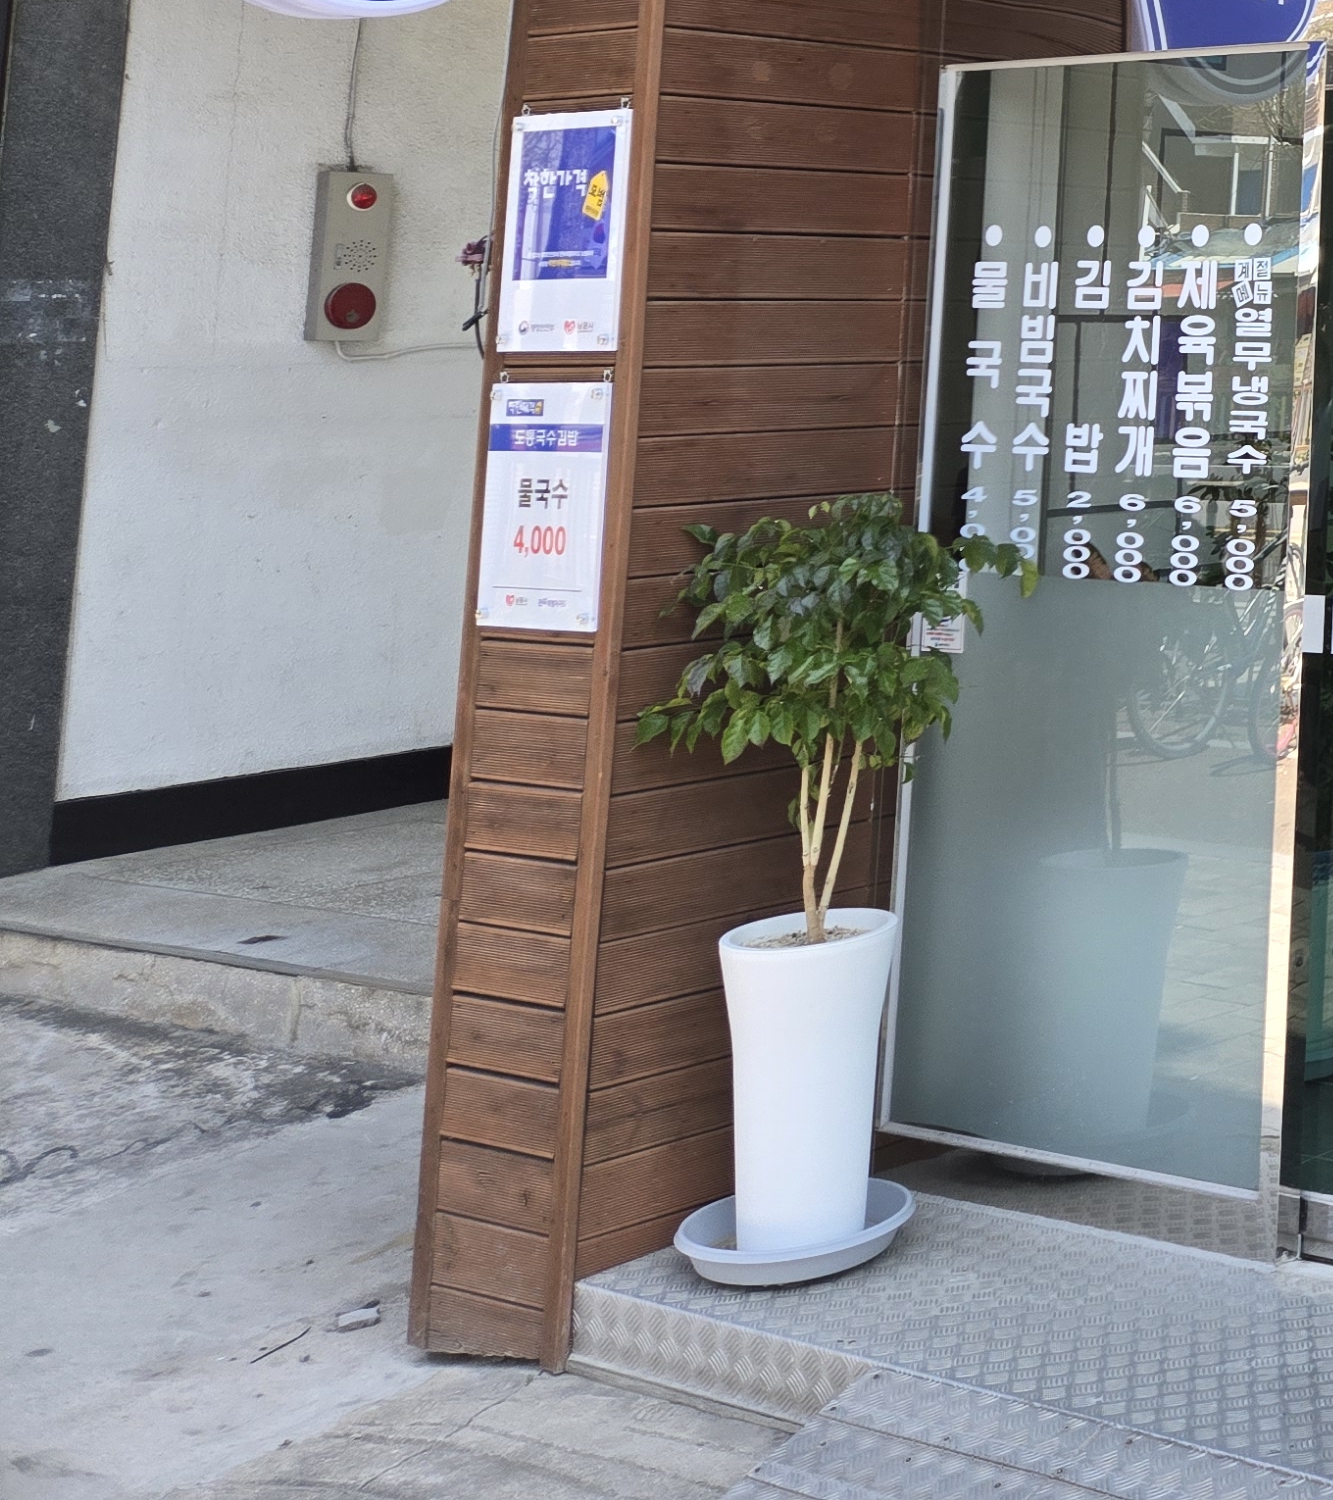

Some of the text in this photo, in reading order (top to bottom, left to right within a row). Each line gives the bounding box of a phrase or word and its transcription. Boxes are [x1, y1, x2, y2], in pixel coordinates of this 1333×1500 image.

[514, 429, 579, 447] 도통국수김밥
[959, 260, 1009, 471] 물국수
[1011, 260, 1061, 473] 비빔국수
[1061, 259, 1112, 581] 김밥 2,000
[1112, 259, 1164, 584] 김치찌개 6,000
[1167, 259, 1221, 587] 제육볶음 6,000
[1223, 306, 1273, 592] 열무냉국수 5,000
[513, 525, 567, 557] 4,000
[517, 478, 569, 509] 물국수
